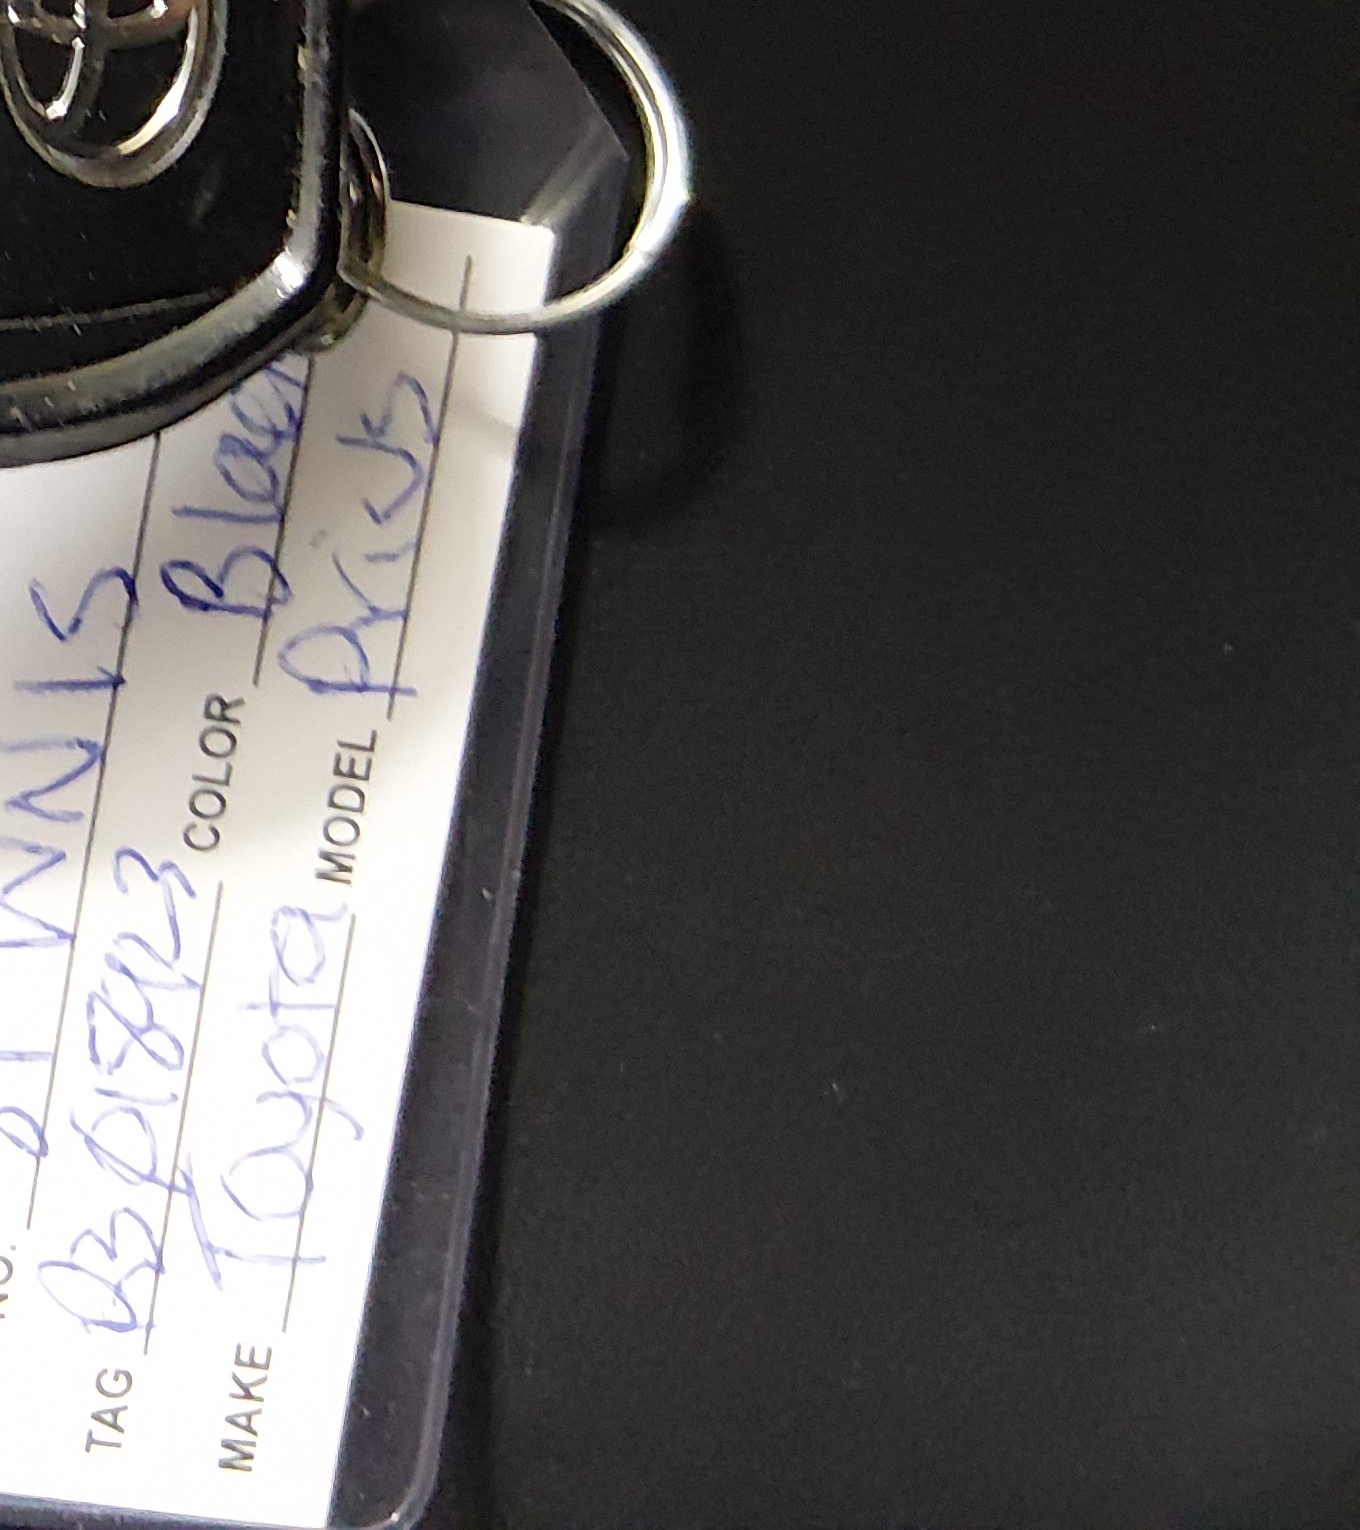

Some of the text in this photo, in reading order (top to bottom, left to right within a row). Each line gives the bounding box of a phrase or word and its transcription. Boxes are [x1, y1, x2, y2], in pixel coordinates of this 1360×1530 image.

[182, 691, 247, 854] COLOR
[313, 727, 379, 888] MODEL
[83, 1365, 134, 1454] TAG
[216, 1340, 274, 1473] MAKE
